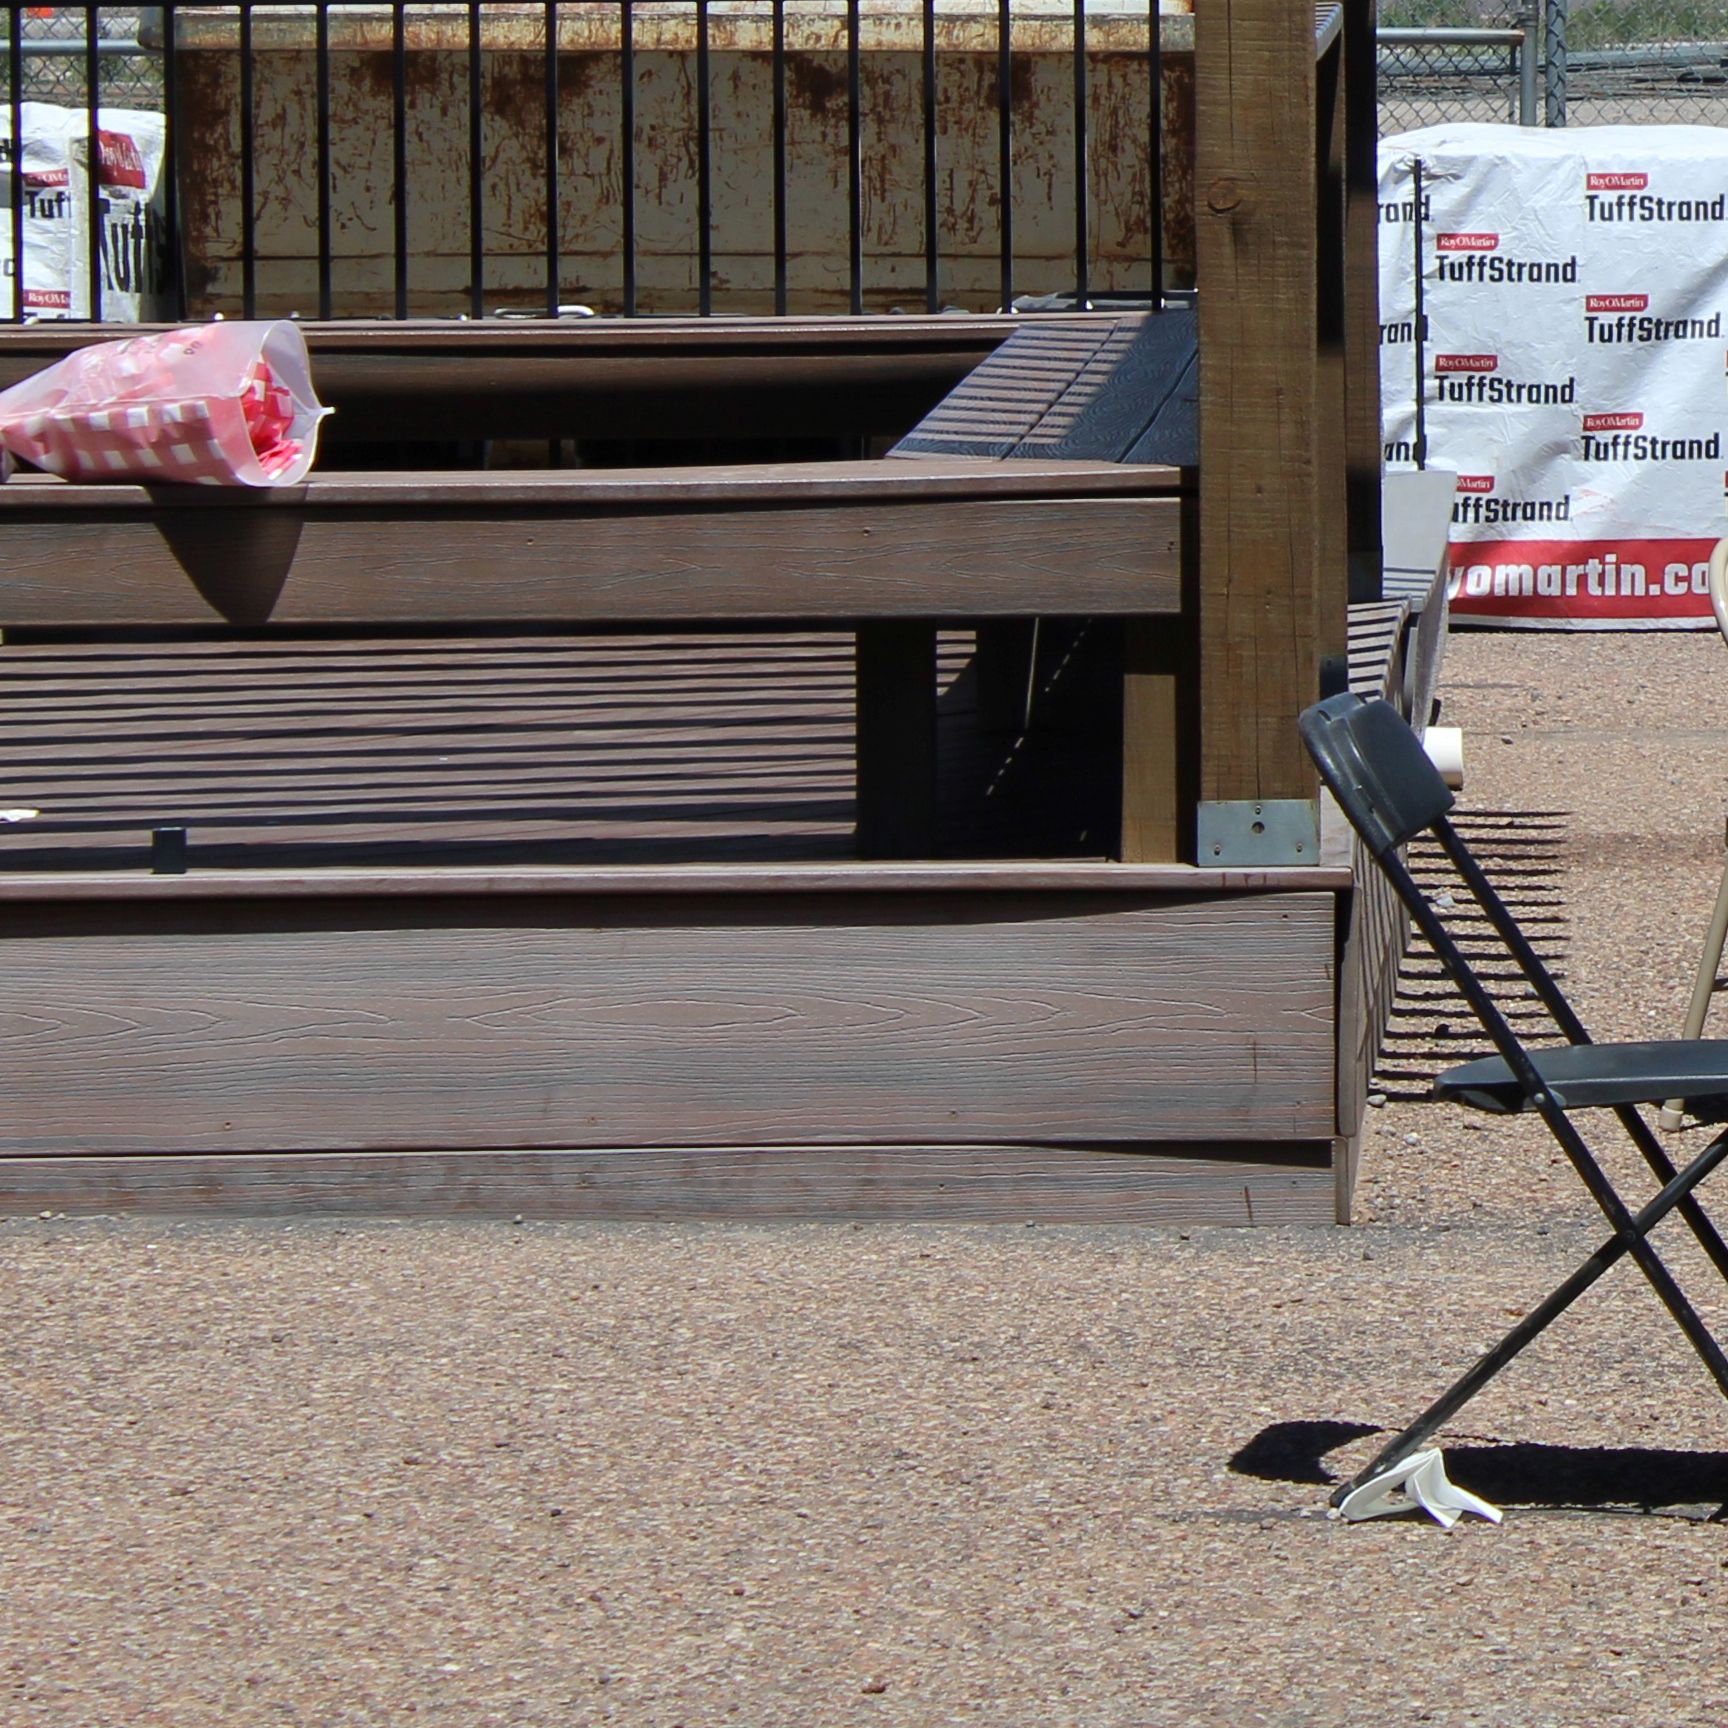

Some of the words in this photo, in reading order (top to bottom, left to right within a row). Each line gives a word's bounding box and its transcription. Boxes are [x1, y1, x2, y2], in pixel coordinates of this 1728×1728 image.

[1590, 175, 1644, 190] RoyOMartin
[1585, 193, 1725, 222] TuffStrand
[1440, 235, 1495, 249] RoyOMartin
[1435, 255, 1577, 283] TuffStrand
[1590, 297, 1644, 311] RoyOMartin
[1584, 312, 1721, 343] TuffStrand
[1439, 357, 1493, 370] RoyOMartin
[1434, 375, 1575, 404] TuffStrand
[1587, 415, 1639, 429] RoyOMartin
[1581, 432, 1720, 461] TuffStrand
